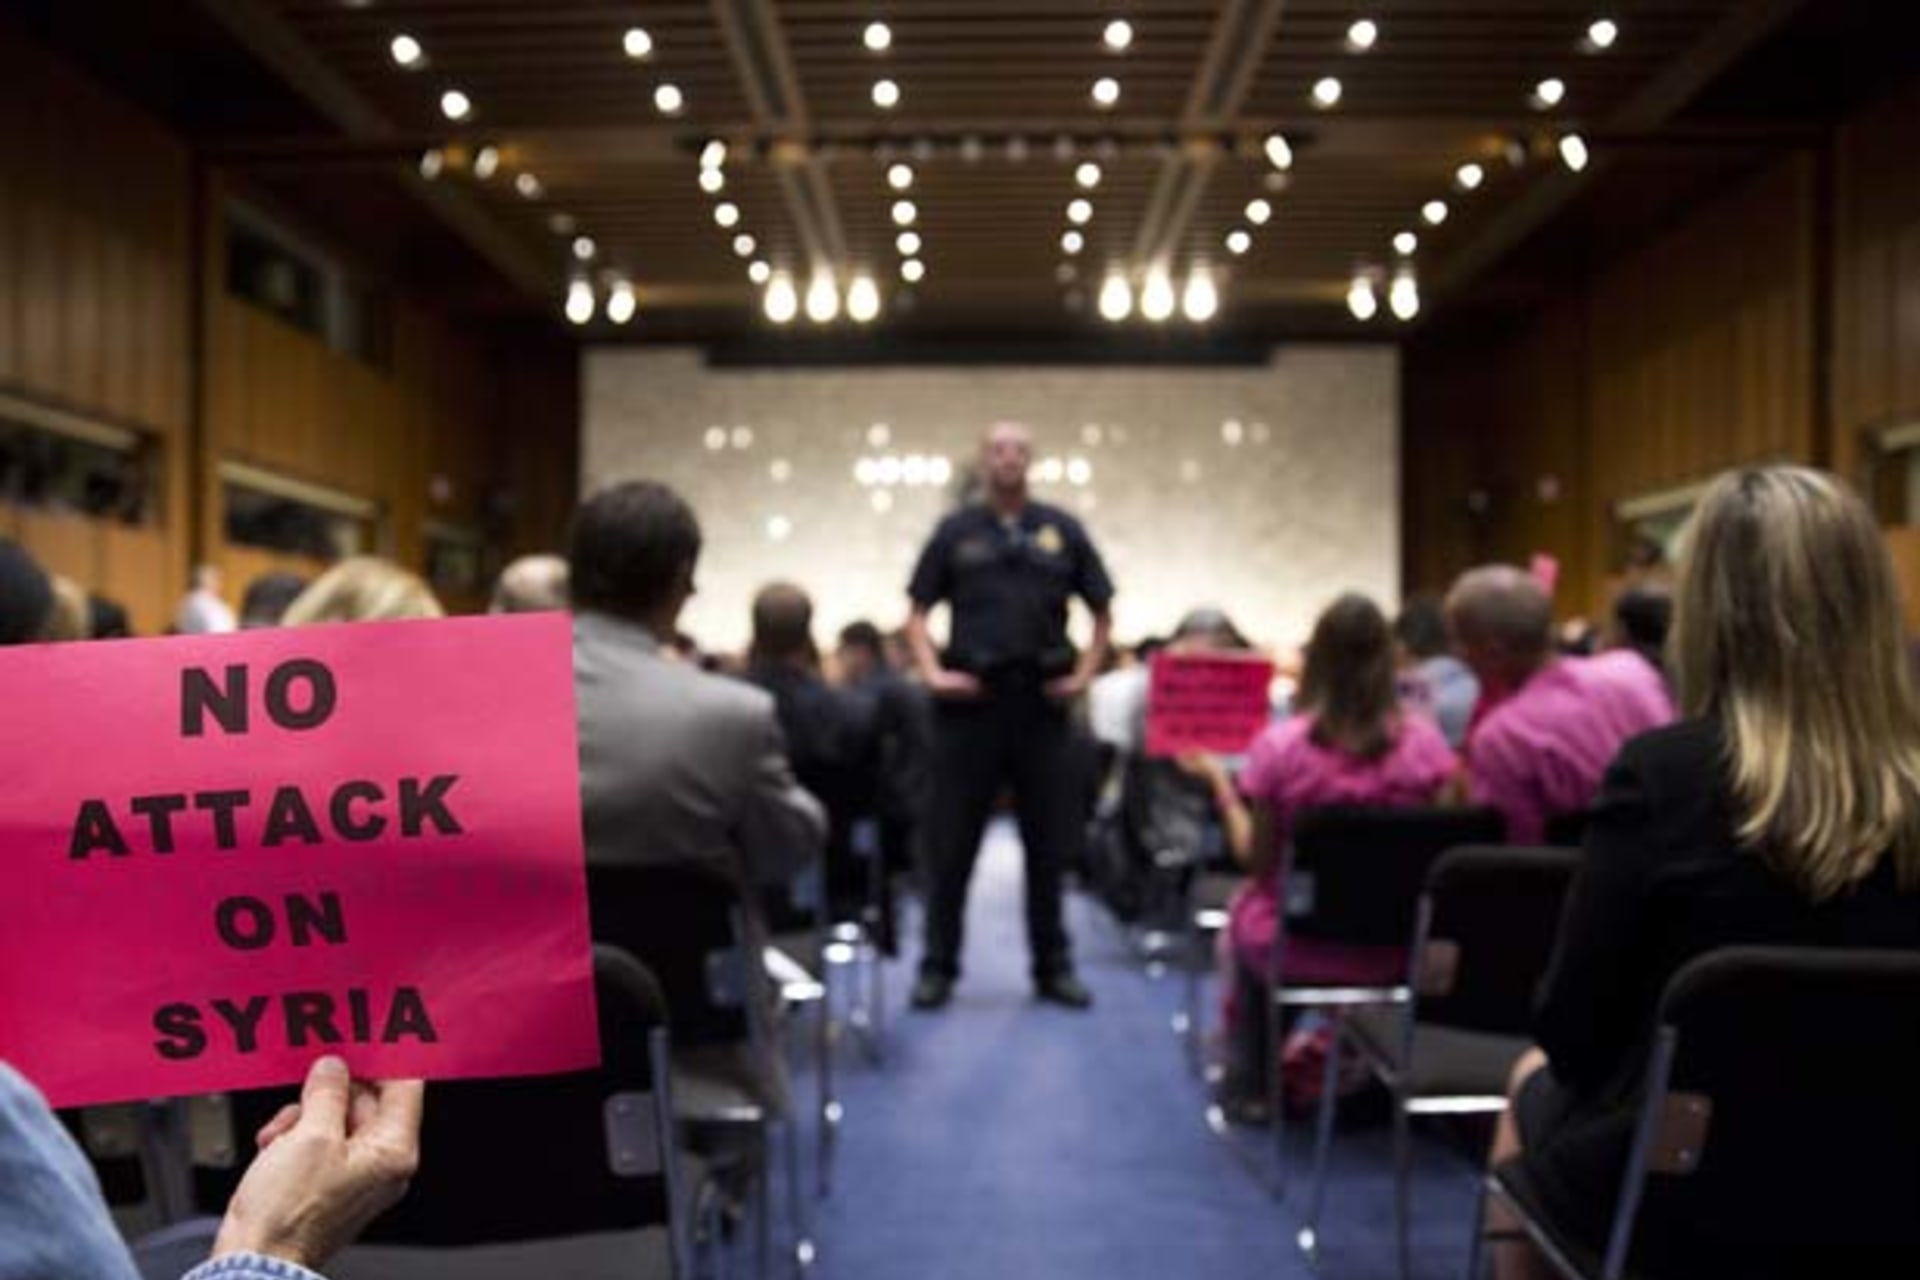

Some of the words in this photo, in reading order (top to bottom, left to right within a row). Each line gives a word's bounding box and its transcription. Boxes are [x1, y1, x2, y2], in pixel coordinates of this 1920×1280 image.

[181, 659, 337, 738] NO
[68, 775, 464, 860] ATTACK
[214, 892, 347, 950] ON
[153, 987, 438, 1060] SYRIA
